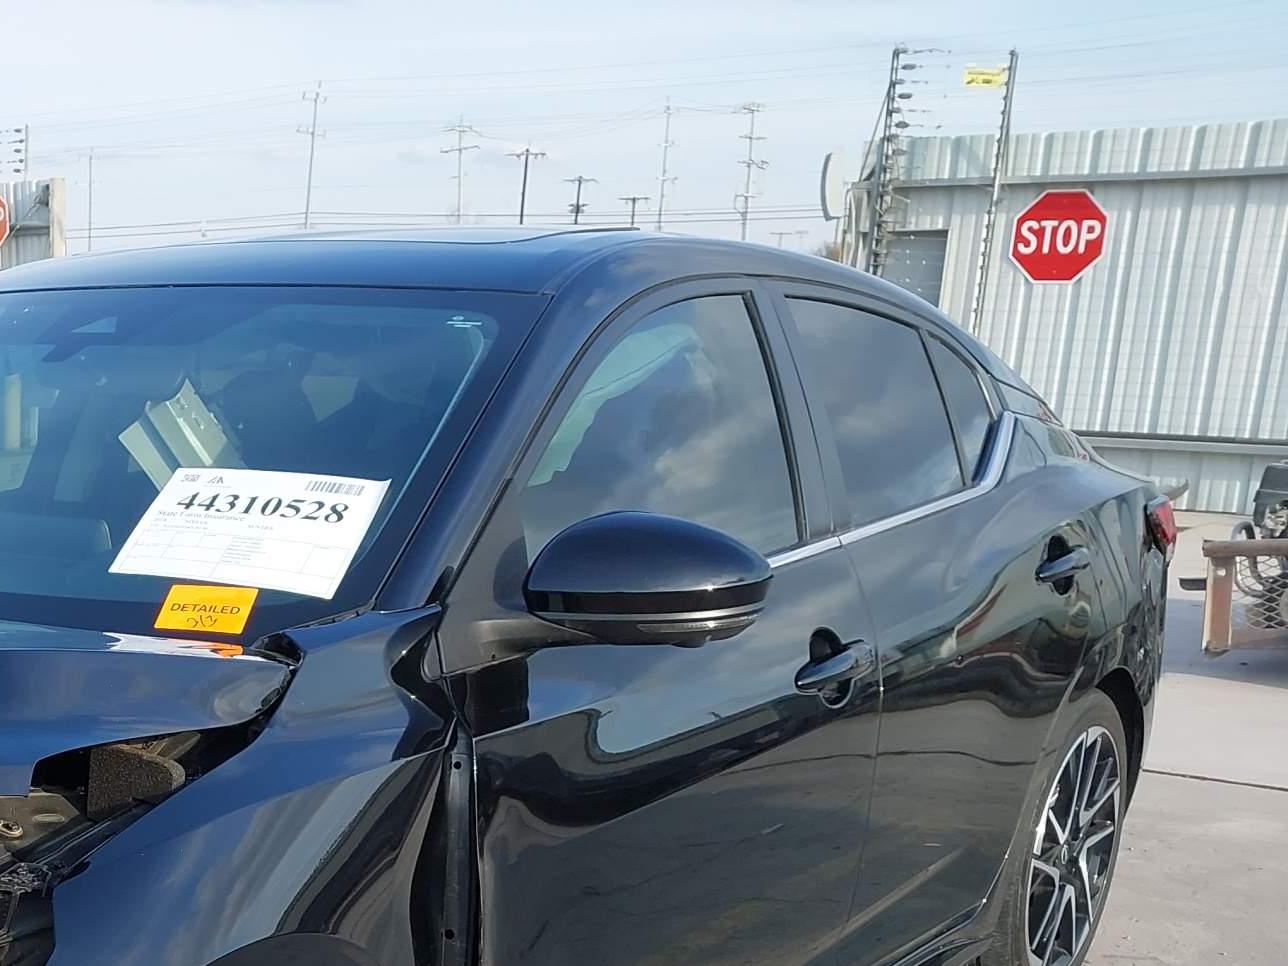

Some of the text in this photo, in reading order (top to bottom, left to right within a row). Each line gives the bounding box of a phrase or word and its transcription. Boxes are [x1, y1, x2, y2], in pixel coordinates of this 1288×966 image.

[1017, 219, 1102, 255] STOP
[177, 491, 349, 524] 44310528
[170, 603, 241, 615] DETAILED
